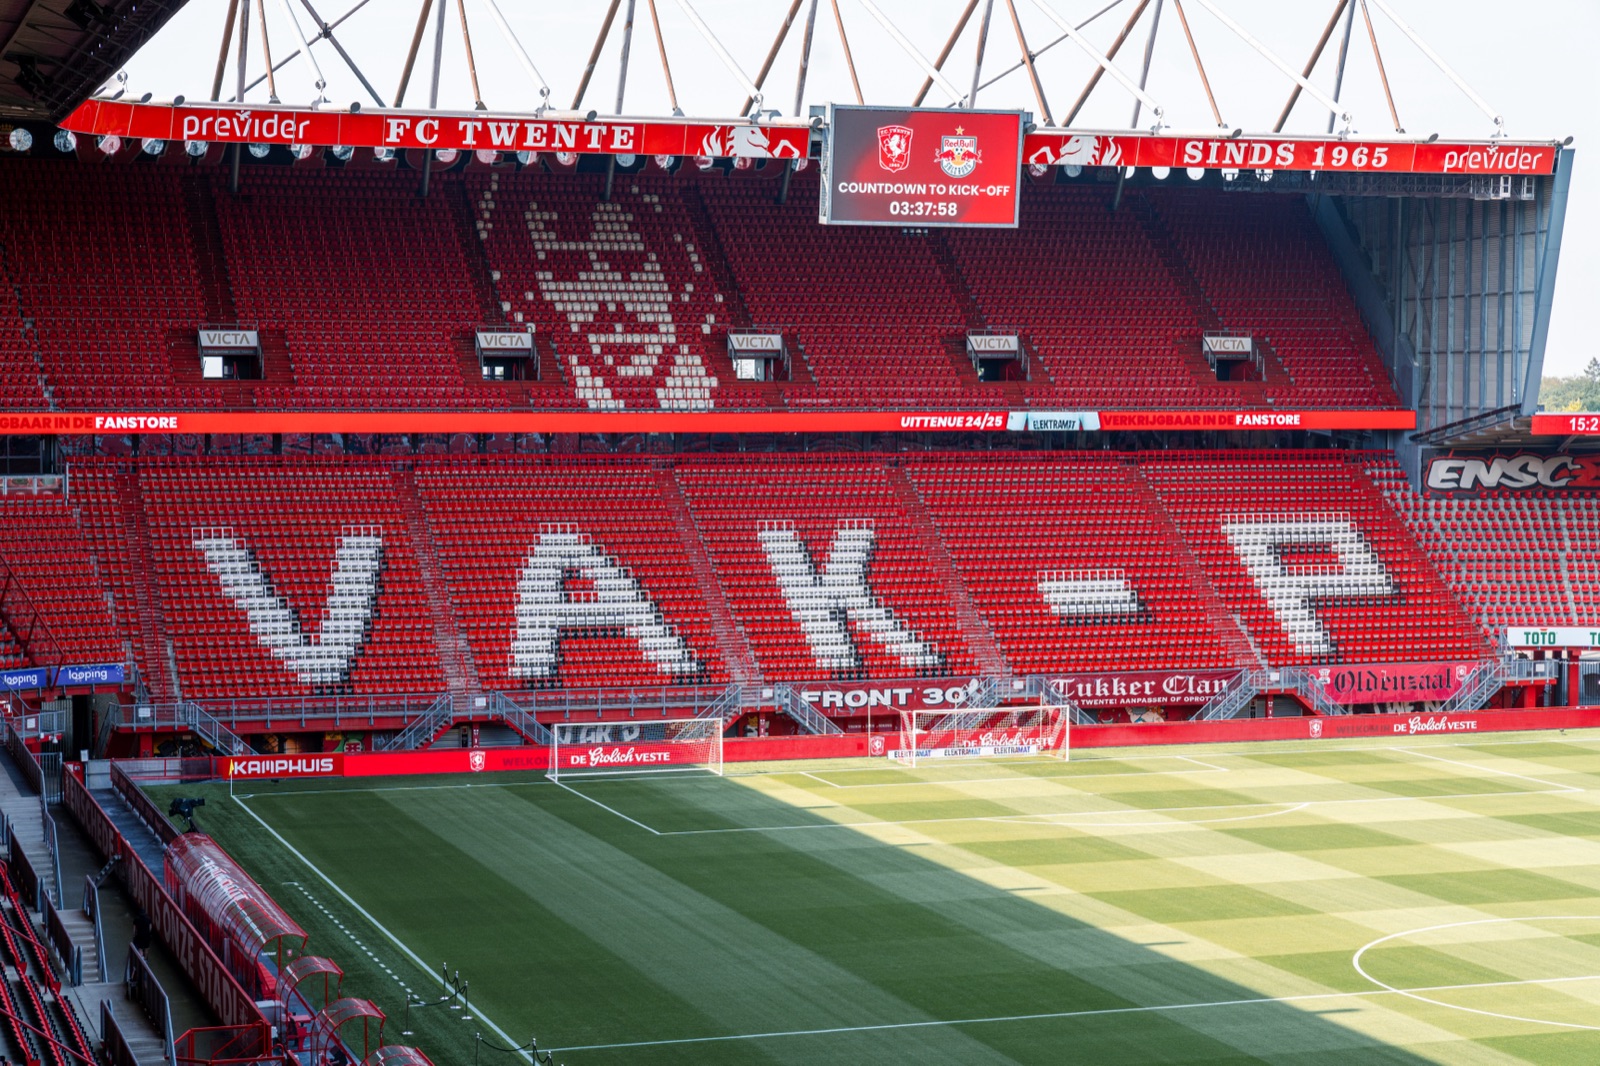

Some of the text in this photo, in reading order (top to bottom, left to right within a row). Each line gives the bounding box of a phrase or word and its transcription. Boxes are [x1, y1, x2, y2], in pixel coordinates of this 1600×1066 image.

[183, 110, 310, 140] previder
[386, 119, 635, 150] FC TWENTE
[944, 139, 974, 148] Red Bull
[1183, 141, 1390, 168] SINDS 1965
[1443, 145, 1543, 173] previder
[838, 182, 1011, 197] COUNTDOWN TO KICK-OFF
[889, 201, 958, 216] 03:37:58
[206, 333, 250, 345] VICTA
[484, 335, 524, 347] VICTA
[736, 336, 775, 349] VICTA
[974, 336, 1012, 350] VICTA
[1210, 338, 1246, 351] VICTA
[55, 417, 70, 429] IN
[73, 417, 93, 429] DE
[95, 416, 178, 429] FANSTORE
[900, 414, 1003, 429] UITTENUE 24/25
[1102, 414, 1301, 426] VERKRIJGBAAR IN DE FANSTORE
[1524, 631, 1556, 645] TOTO
[4, 674, 37, 686] looping
[68, 669, 107, 681] looping
[1333, 668, 1452, 693] Oldenzaal
[1050, 675, 1228, 698] Tukker Clan
[801, 688, 913, 708] FRONT
[1336, 724, 1380, 734] WELKOM
[1394, 724, 1407, 733] DE
[1408, 716, 1447, 734] Grolsch
[1447, 720, 1478, 730] VESTE
[571, 754, 587, 765] DE
[588, 746, 635, 767] Grolsch
[635, 752, 671, 762] VESTE
[944, 747, 981, 756] ELEKTRAMAT
[994, 746, 1030, 755] ELEKTRAMAT
[234, 758, 333, 775] KAMPHUIS
[131, 856, 148, 912] DAT
[152, 885, 161, 930] IS
[162, 902, 194, 979] ONZE
